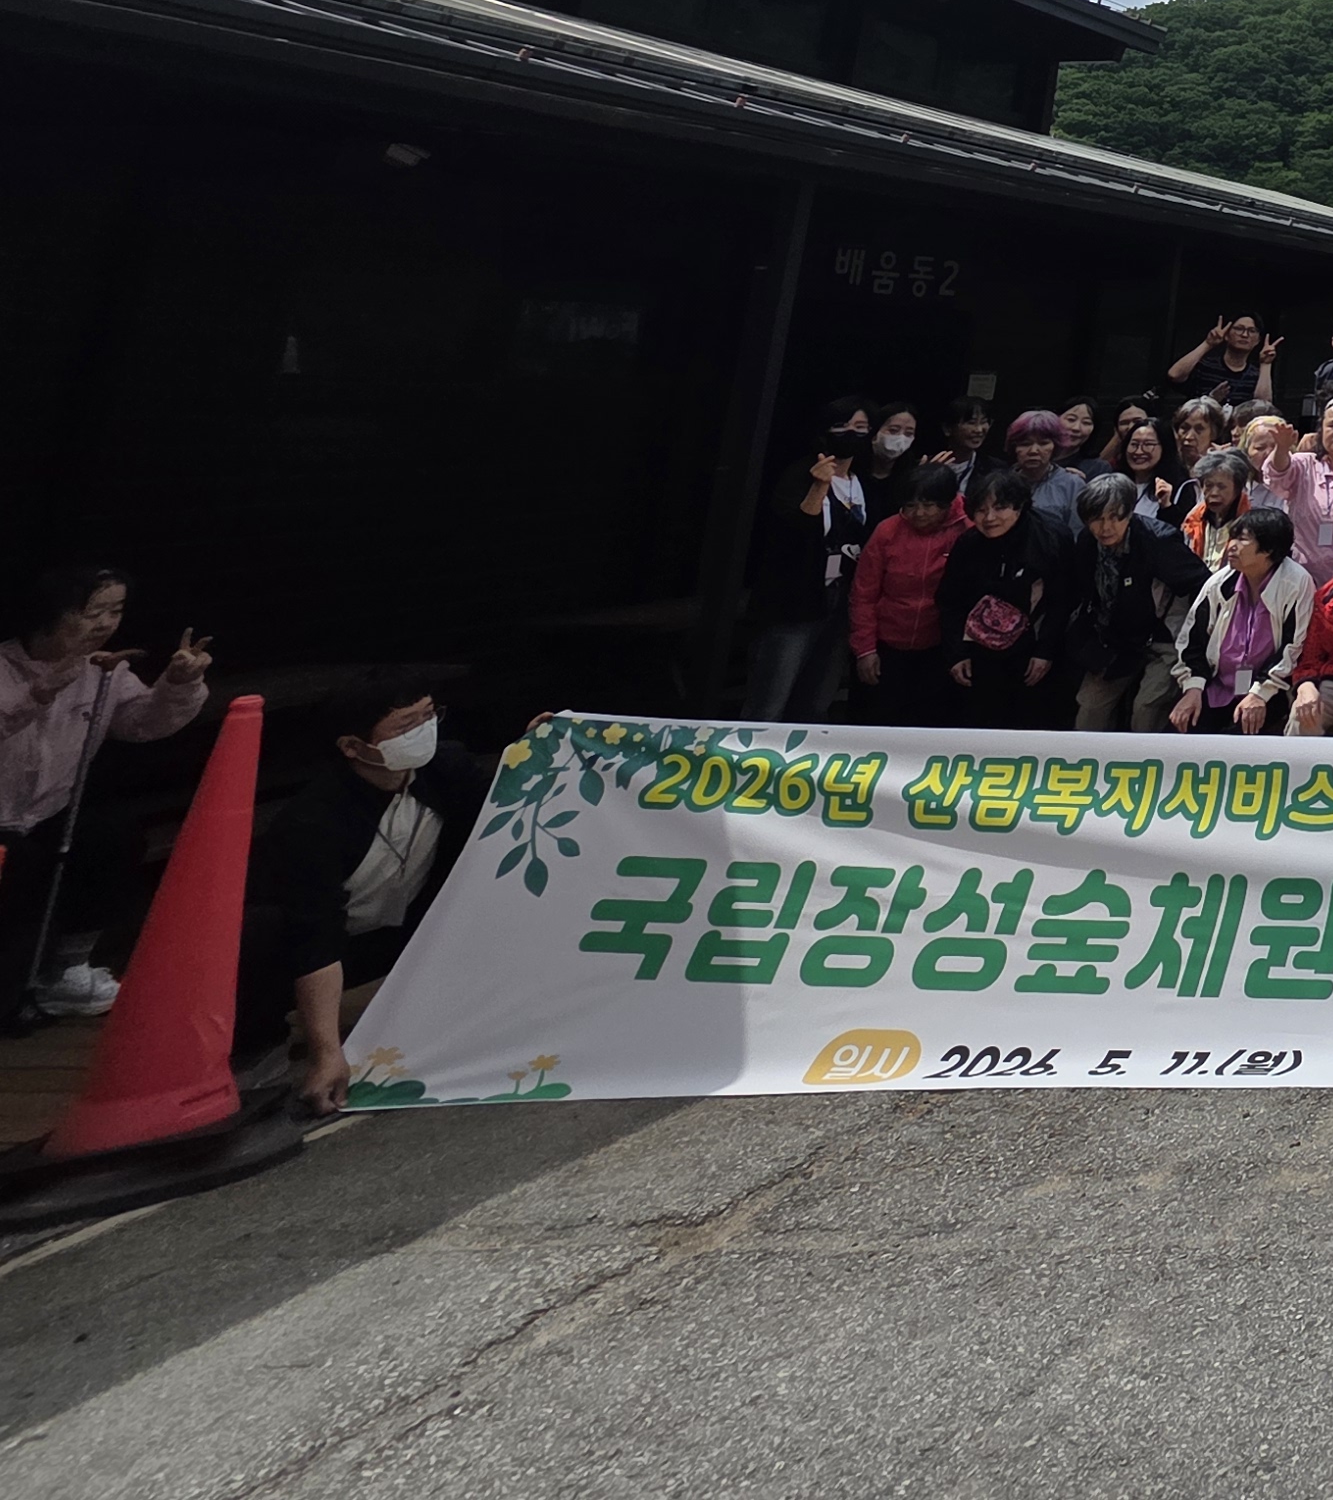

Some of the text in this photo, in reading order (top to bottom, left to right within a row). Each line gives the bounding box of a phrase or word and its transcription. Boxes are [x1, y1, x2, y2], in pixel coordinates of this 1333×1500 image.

[834, 247, 960, 297] 배움동2
[641, 752, 884, 824] 2026년
[821, 1044, 1303, 1080] 일시 2026. 5. 11.(월)
